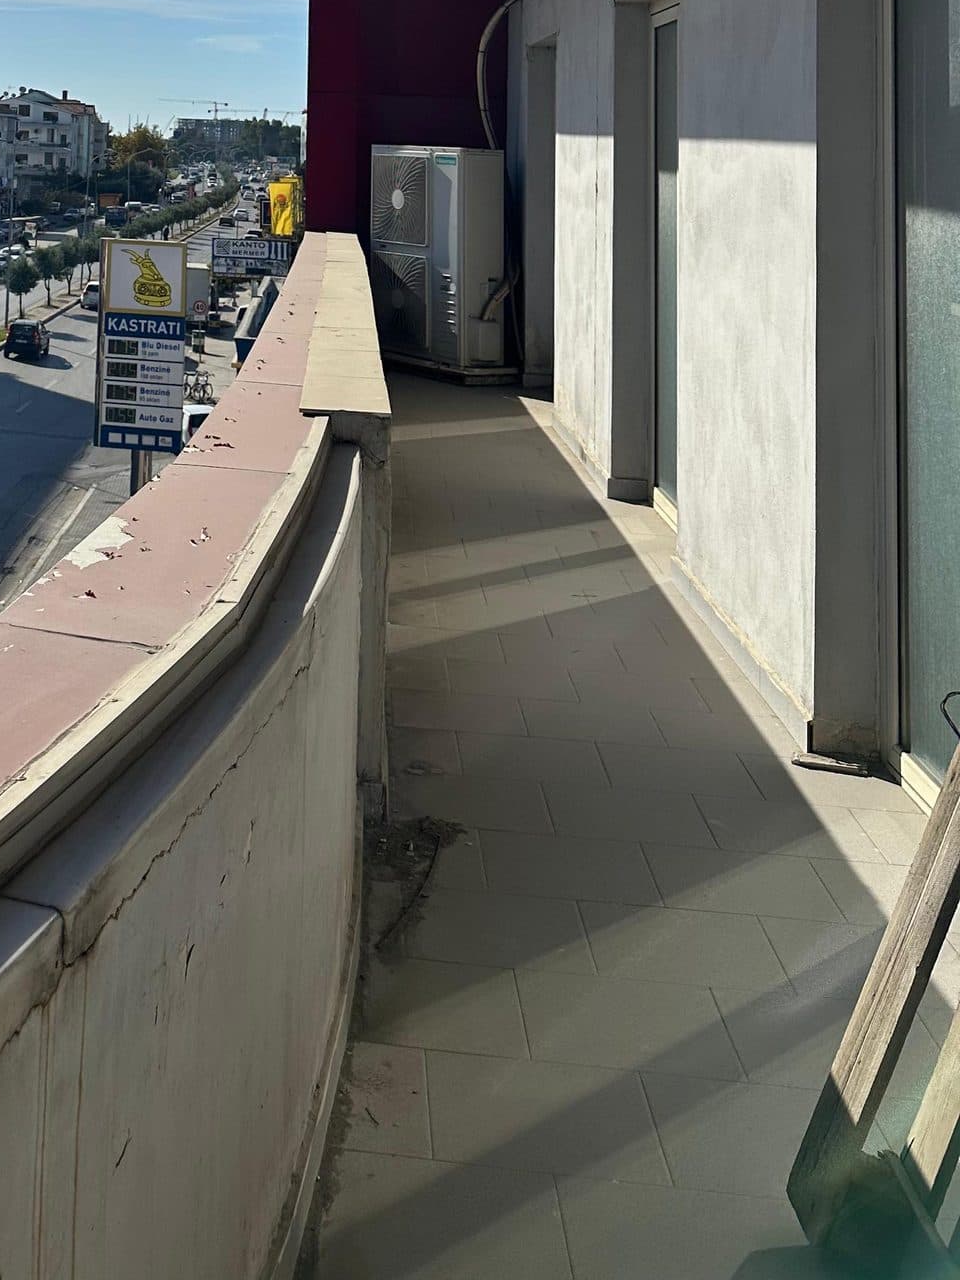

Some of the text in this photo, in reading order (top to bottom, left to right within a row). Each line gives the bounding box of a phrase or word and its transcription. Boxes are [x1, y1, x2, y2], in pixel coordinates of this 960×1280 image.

[232, 241, 266, 249] KANTO
[108, 317, 181, 336] KASTRATI
[141, 341, 180, 351] Blu Diesel
[139, 413, 174, 423] Auto Gaz
